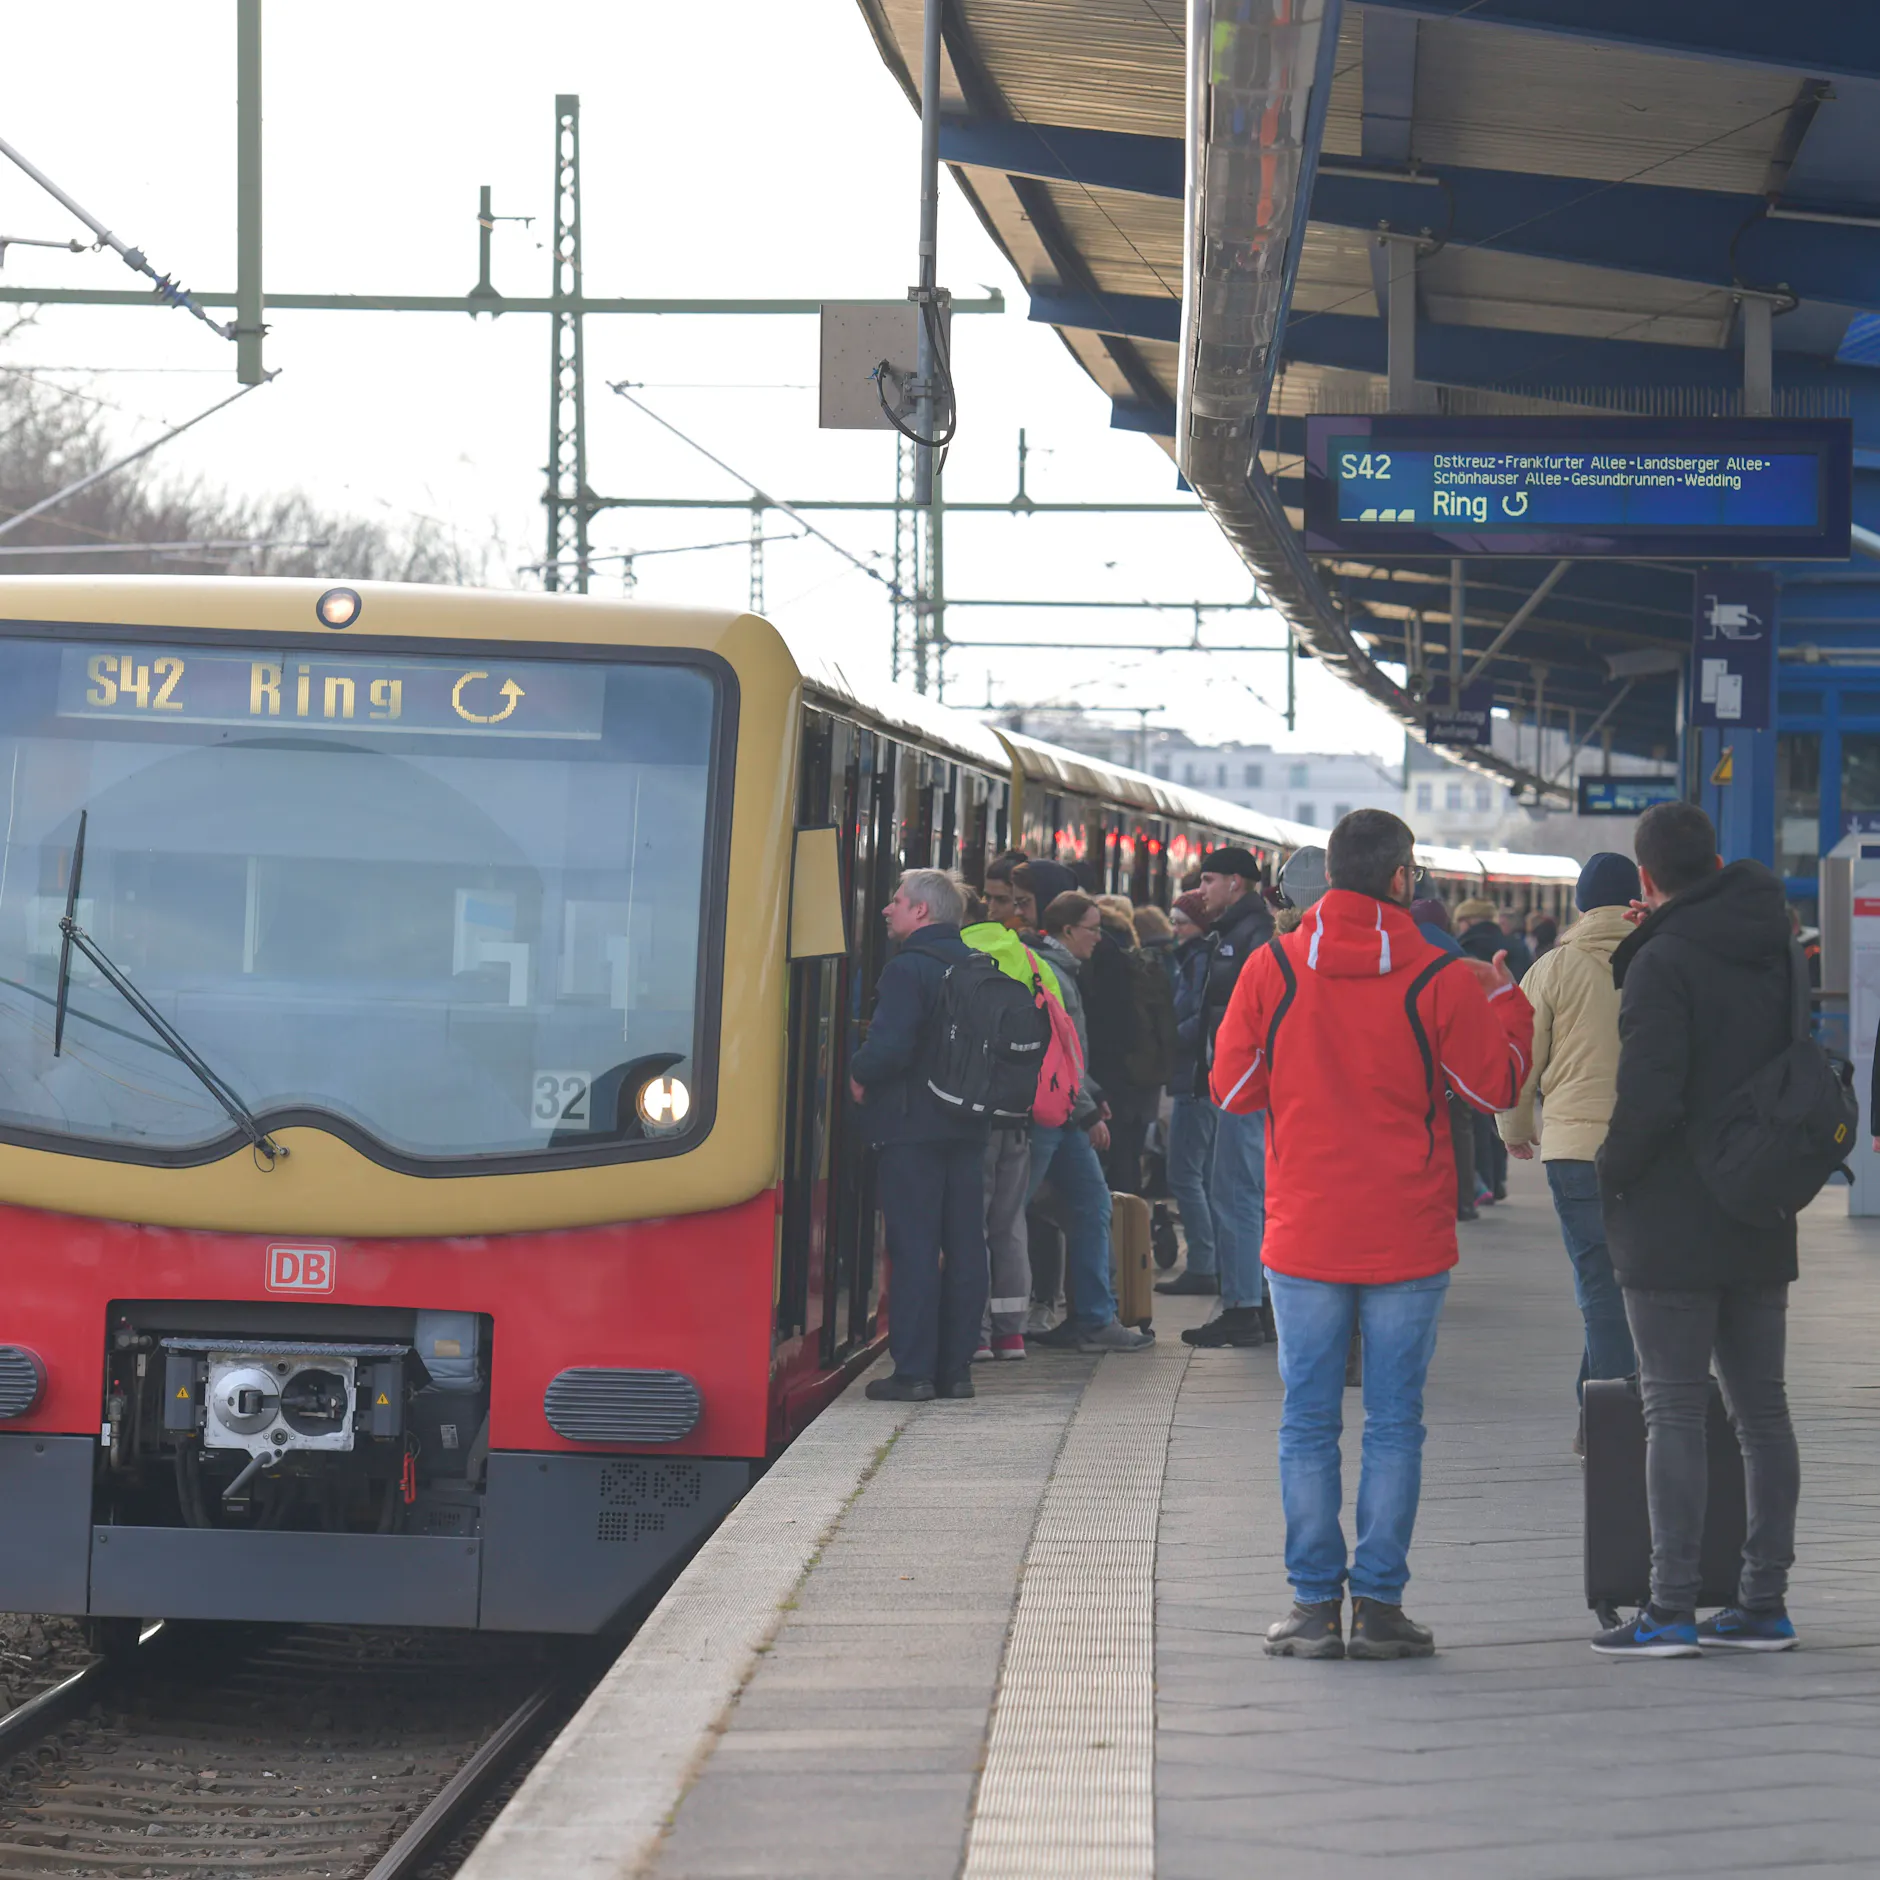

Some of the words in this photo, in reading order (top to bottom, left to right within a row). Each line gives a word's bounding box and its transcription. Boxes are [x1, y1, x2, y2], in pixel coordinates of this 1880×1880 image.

[1341, 453, 1392, 480] S42
[1433, 471, 1519, 485] Schönhauser
[1433, 490, 1488, 523] Ring
[86, 654, 185, 712] S42
[249, 662, 403, 720] Ring
[535, 1075, 587, 1121] 32
[274, 1251, 327, 1286] DB
